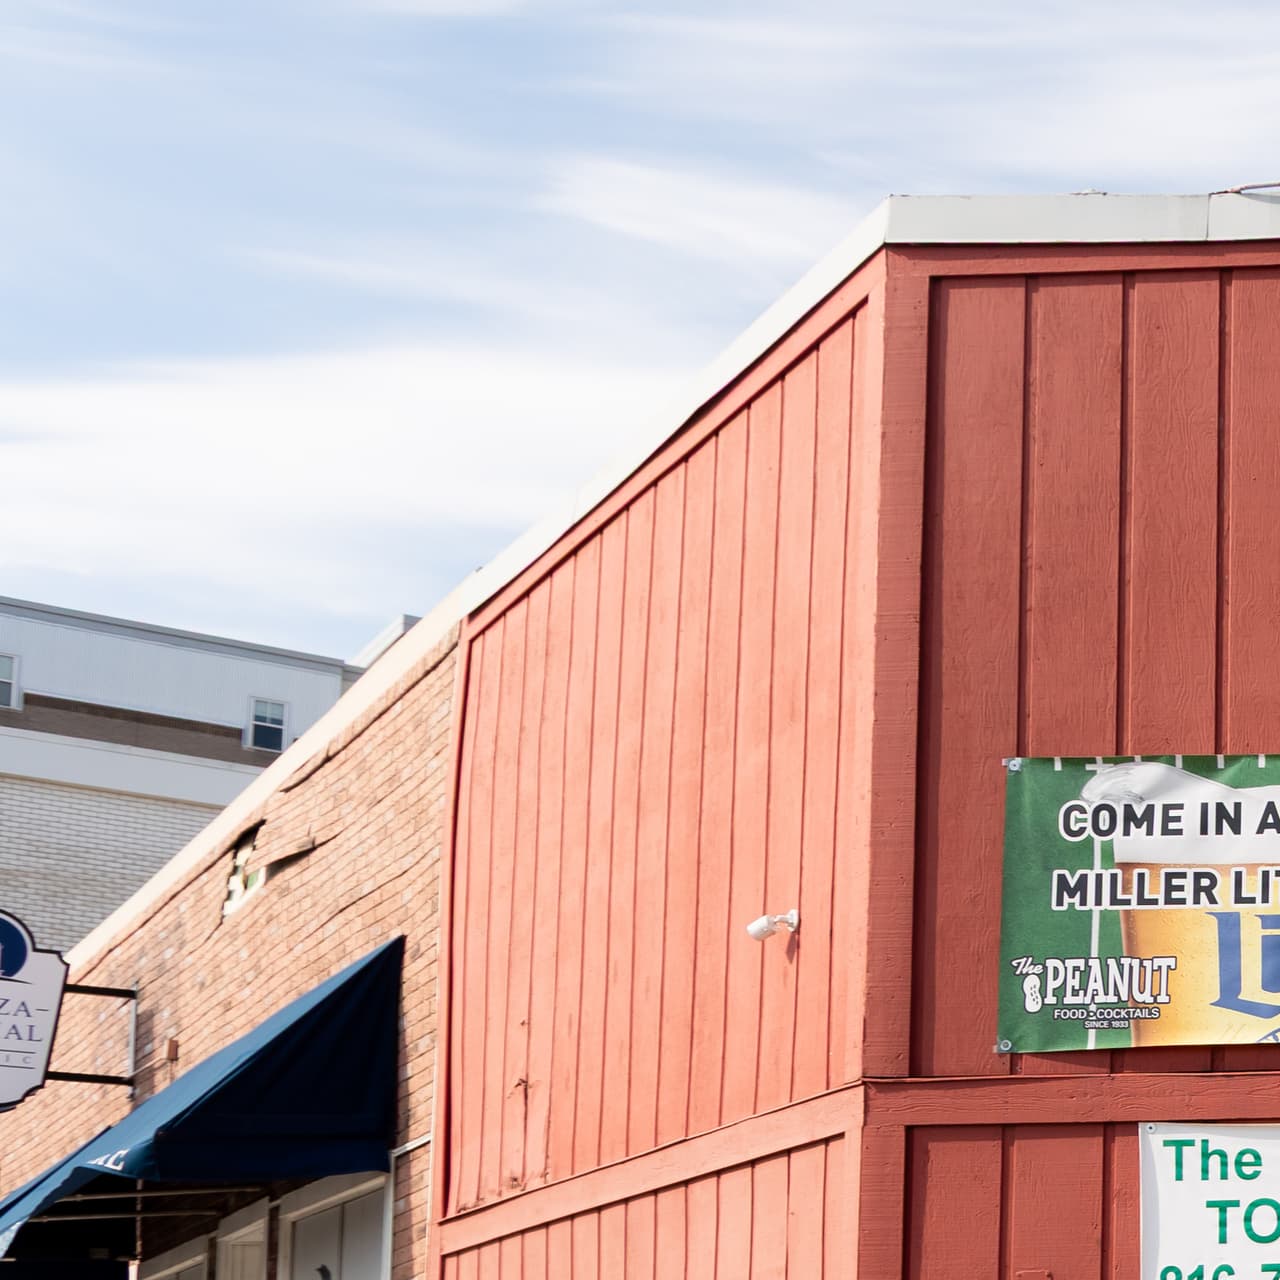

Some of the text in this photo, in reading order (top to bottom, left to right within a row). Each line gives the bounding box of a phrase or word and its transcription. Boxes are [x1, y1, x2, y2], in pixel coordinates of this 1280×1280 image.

[1062, 802, 1185, 838] COME
[1199, 801, 1242, 836] IN
[1055, 870, 1219, 908] MILLER
[1011, 956, 1177, 1005] The PEANUT
[1054, 1007, 1160, 1019] FOOD COCKTAILS
[1084, 1020, 1129, 1029] SINCE 1933
[1162, 1137, 1263, 1182] The
